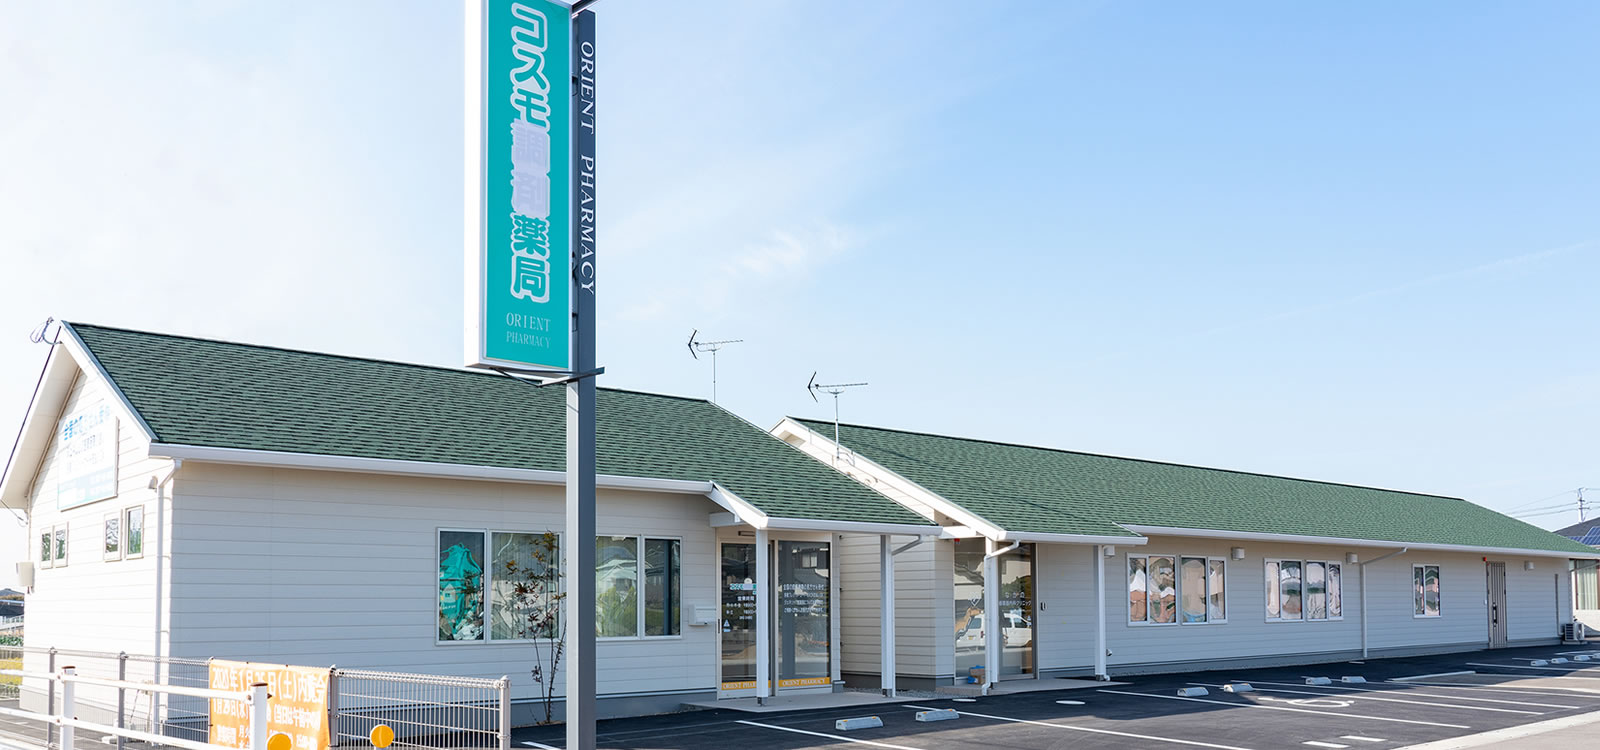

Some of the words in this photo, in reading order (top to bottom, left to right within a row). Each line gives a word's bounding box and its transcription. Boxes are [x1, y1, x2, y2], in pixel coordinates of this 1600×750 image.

[581, 41, 594, 135] ORIENT
[581, 154, 594, 295] PHARMACY
[506, 312, 551, 332] ORIENT
[506, 331, 551, 349] PHARMACY
